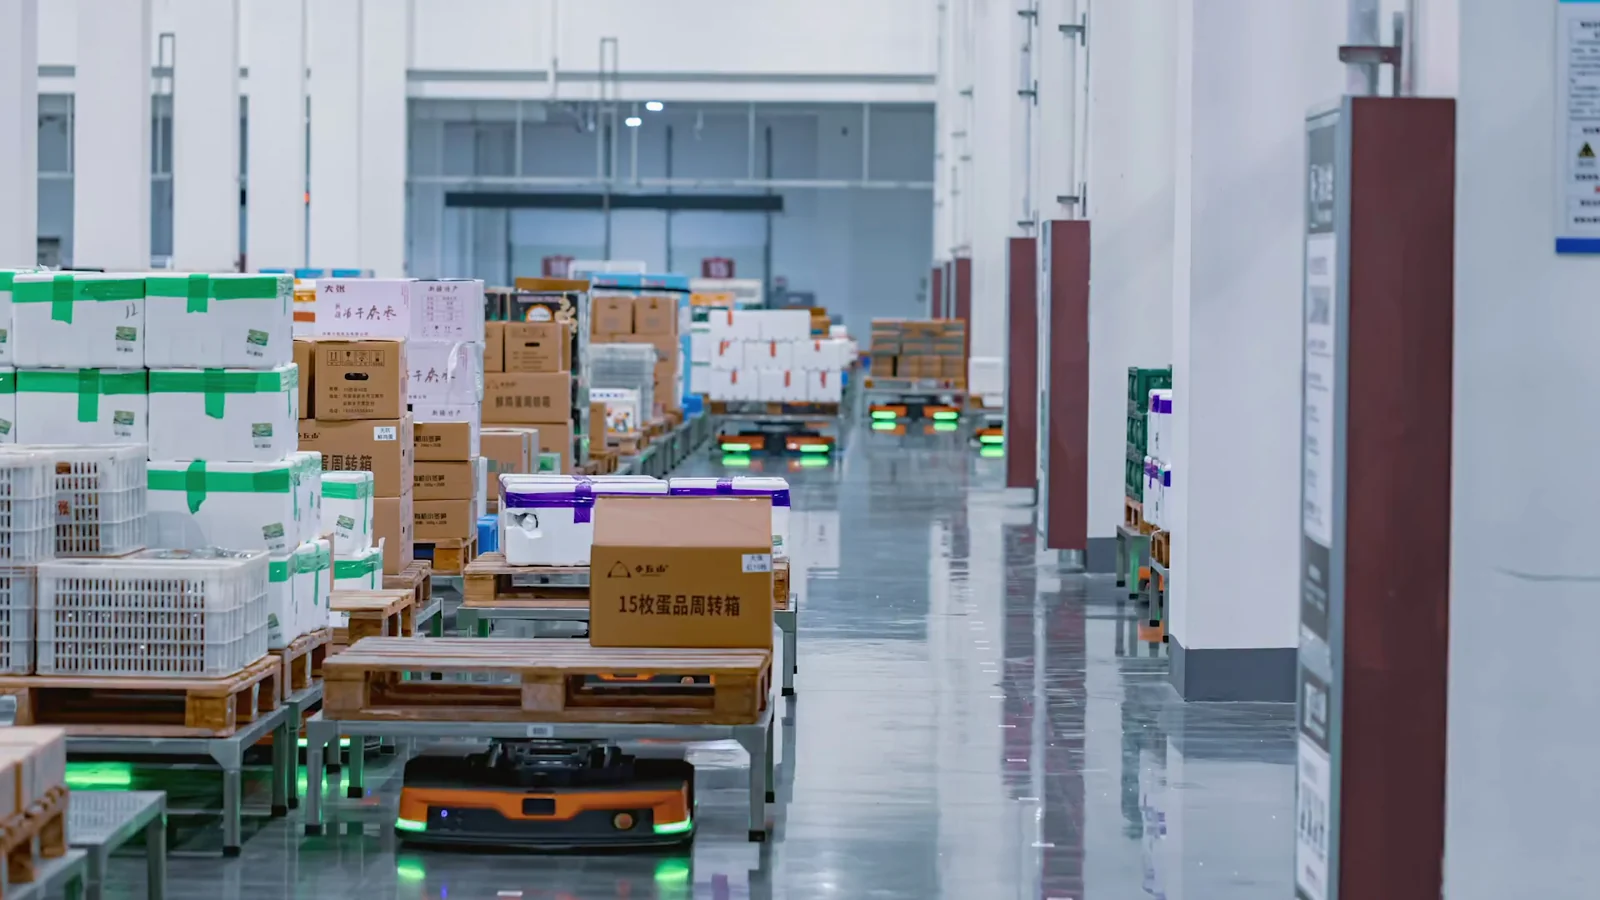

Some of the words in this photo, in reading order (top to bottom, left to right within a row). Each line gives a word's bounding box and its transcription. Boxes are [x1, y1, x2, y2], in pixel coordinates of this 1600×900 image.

[618, 594, 741, 617] 15枚蛋品周转箱
